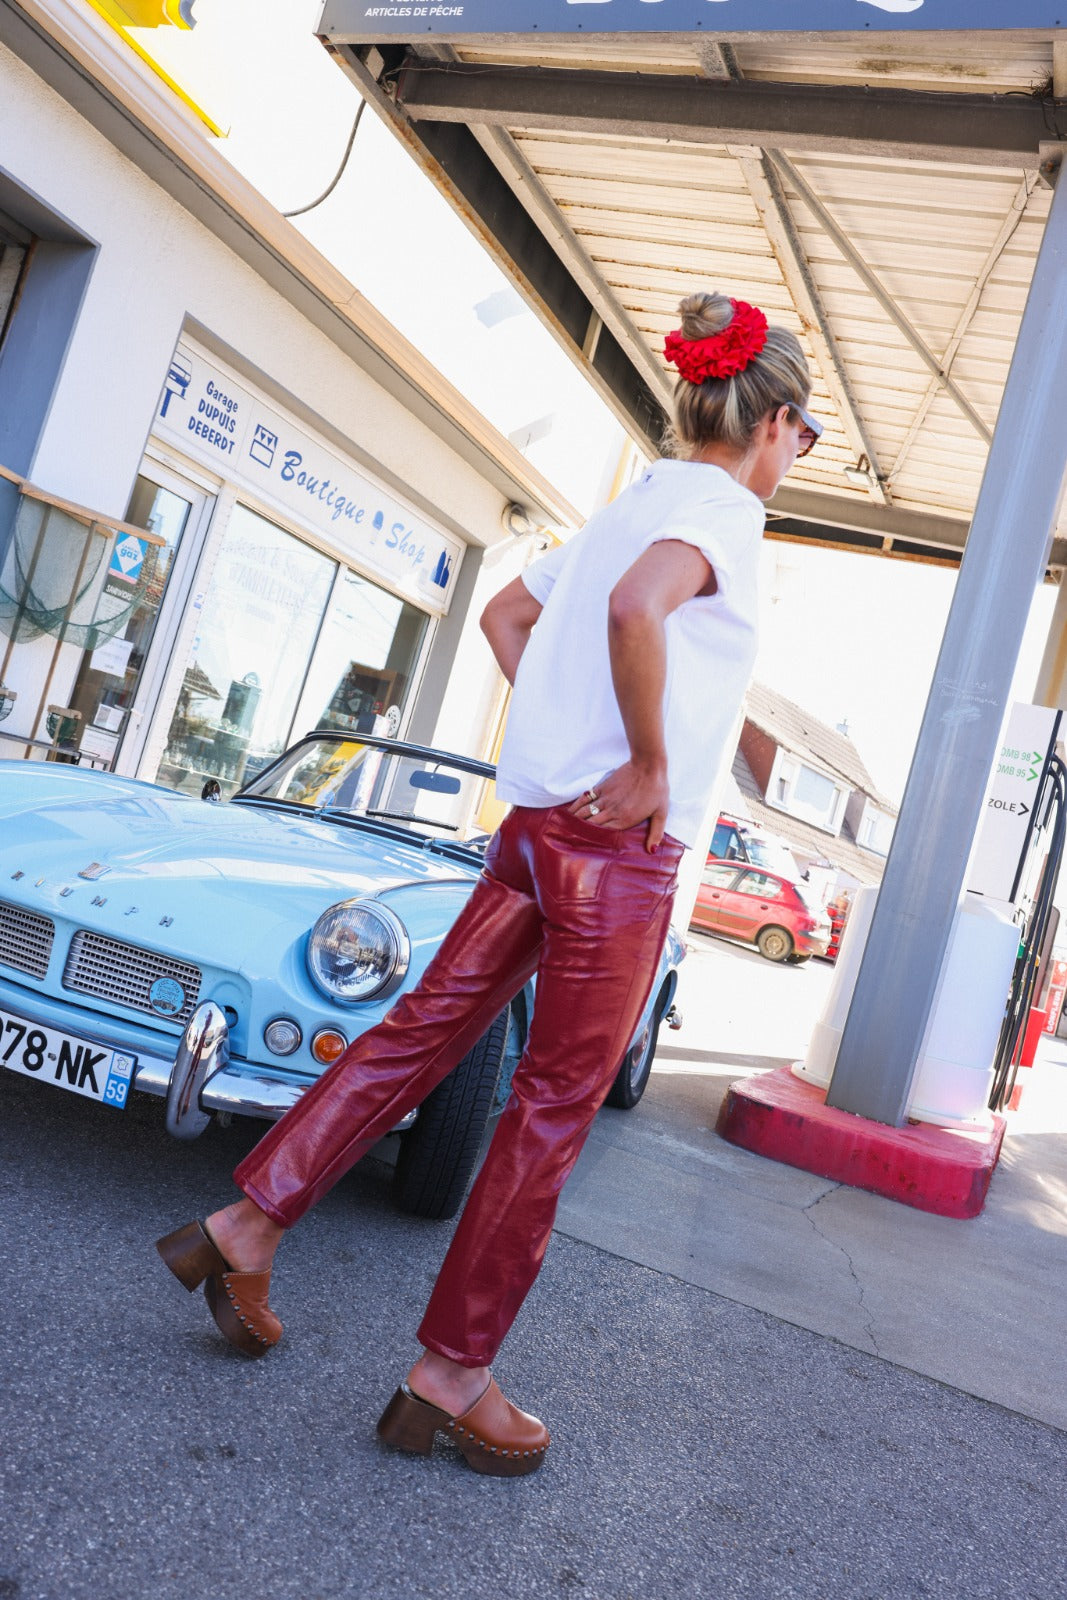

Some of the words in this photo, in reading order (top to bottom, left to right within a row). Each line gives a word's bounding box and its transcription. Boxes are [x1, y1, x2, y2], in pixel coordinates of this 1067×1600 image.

[364, 7, 412, 17] ARTICLES
[413, 7, 428, 16] DE
[429, 4, 464, 16] PÊCHE
[206, 380, 239, 413] Garage
[197, 398, 236, 433] DUPUIS
[187, 415, 235, 455] DEBERDT
[280, 450, 365, 524] Boutique
[385, 522, 426, 567] Shop
[119, 547, 139, 561] gaz
[1021, 752, 1031, 761] 98
[1015, 768, 1026, 778] 95
[105, 1079, 127, 1103] 59
